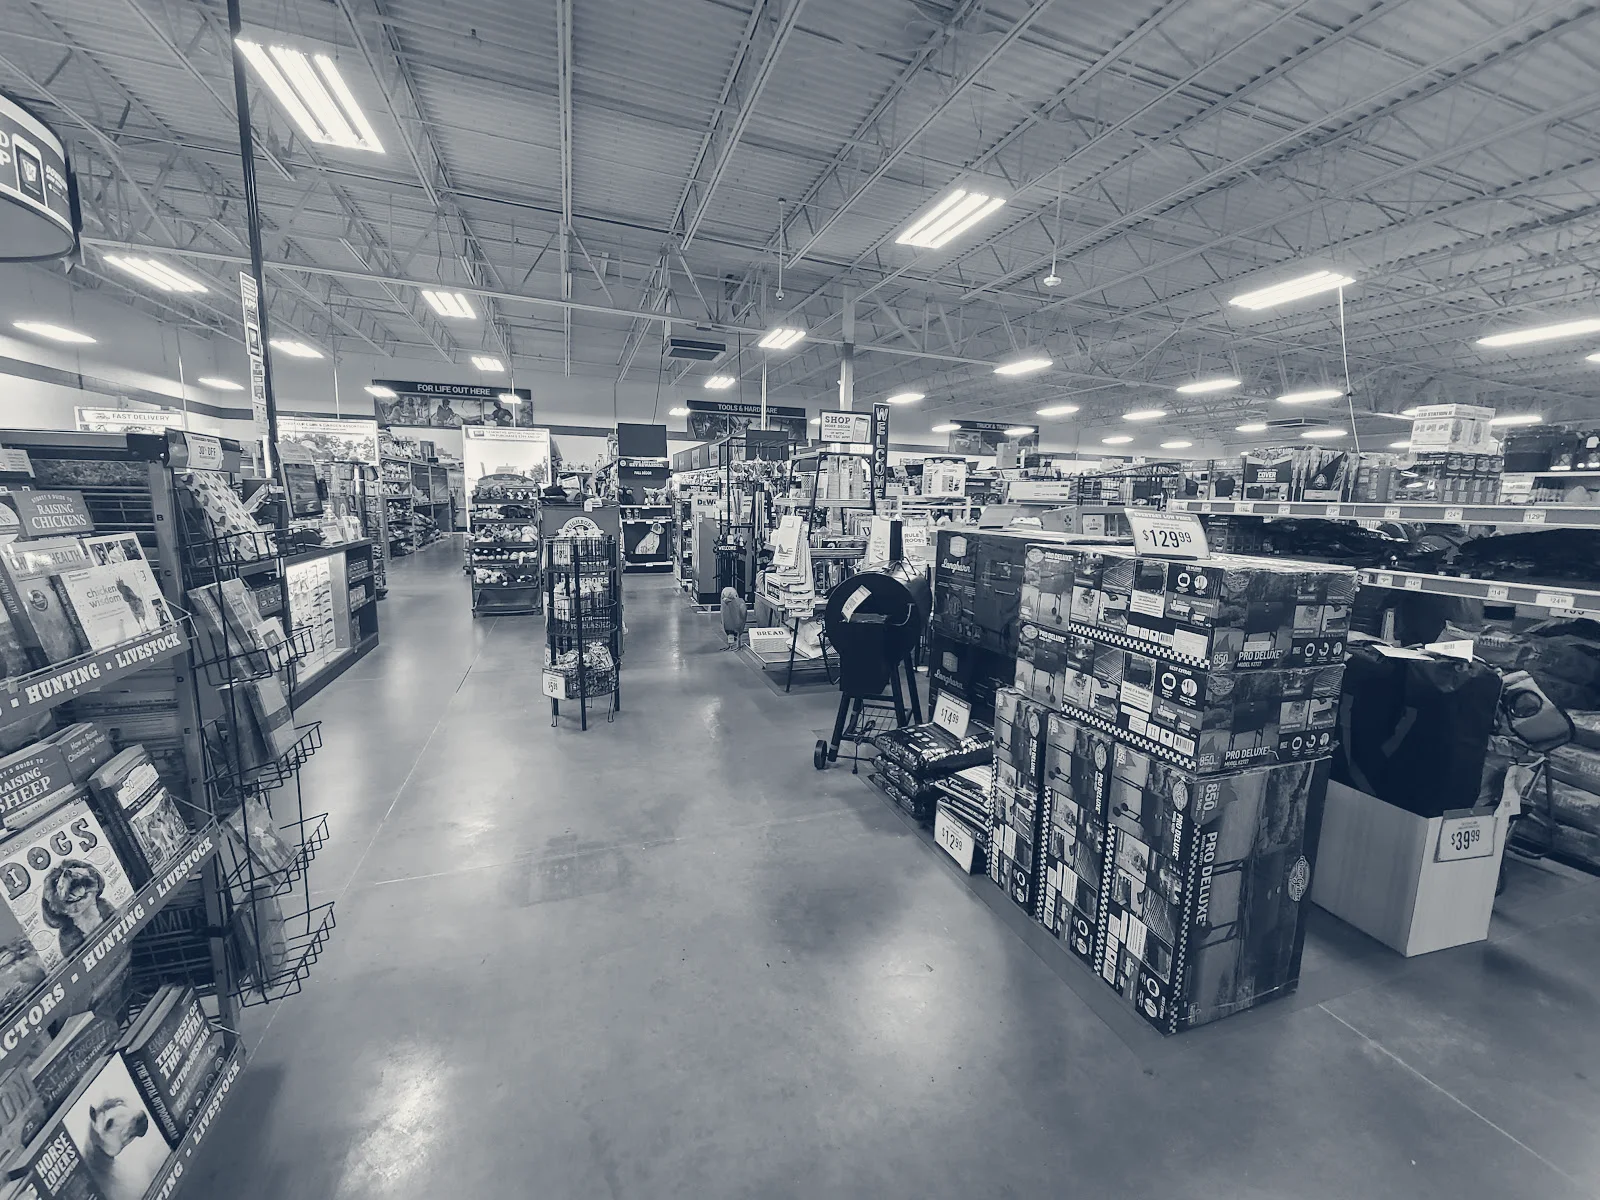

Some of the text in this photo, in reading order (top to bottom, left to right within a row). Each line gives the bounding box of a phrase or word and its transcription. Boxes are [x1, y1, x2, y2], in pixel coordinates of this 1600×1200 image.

[417, 384, 490, 396] FOR LIFE OUT HERE
[717, 403, 738, 411] TOOLS
[744, 405, 778, 414] HARDARE
[824, 416, 850, 424] SHOP
[873, 407, 889, 501] WELCOME
[1257, 471, 1277, 479] COVER
[31, 513, 87, 529] CHICKENS
[36, 503, 74, 515] RAISING
[52, 550, 80, 565] HEALTH
[86, 585, 117, 598] chicken
[89, 594, 121, 609] wisdom
[114, 631, 182, 669] LIVESTOCK
[1213, 653, 1229, 665] 850
[1238, 649, 1281, 661] PRO DELUXE
[25, 662, 102, 705] HUNTING
[1199, 755, 1215, 766] 850
[1225, 747, 1269, 761] PRO DELUXE
[124, 779, 135, 792] 50
[1203, 783, 1218, 811] 850
[1172, 812, 1184, 861] PRO DELUXE
[0, 817, 98, 901] DOGS
[155, 836, 214, 899] LIVESTOCK
[1195, 831, 1218, 925] PRO DELUXE
[81, 903, 147, 973] HUNTING
[155, 1039, 176, 1067] THE
[173, 1013, 190, 1043] BEST
[189, 1000, 198, 1017] OF
[160, 1045, 182, 1080] THE
[180, 1011, 204, 1049] TOTAL
[169, 1026, 211, 1097] OUTDOORSMAN
[141, 1077, 158, 1099] TOTAL
[152, 1096, 180, 1141] OUTDOORSMAN
[192, 1060, 241, 1146] LIVESTOCK
[34, 1131, 71, 1179] HORSE
